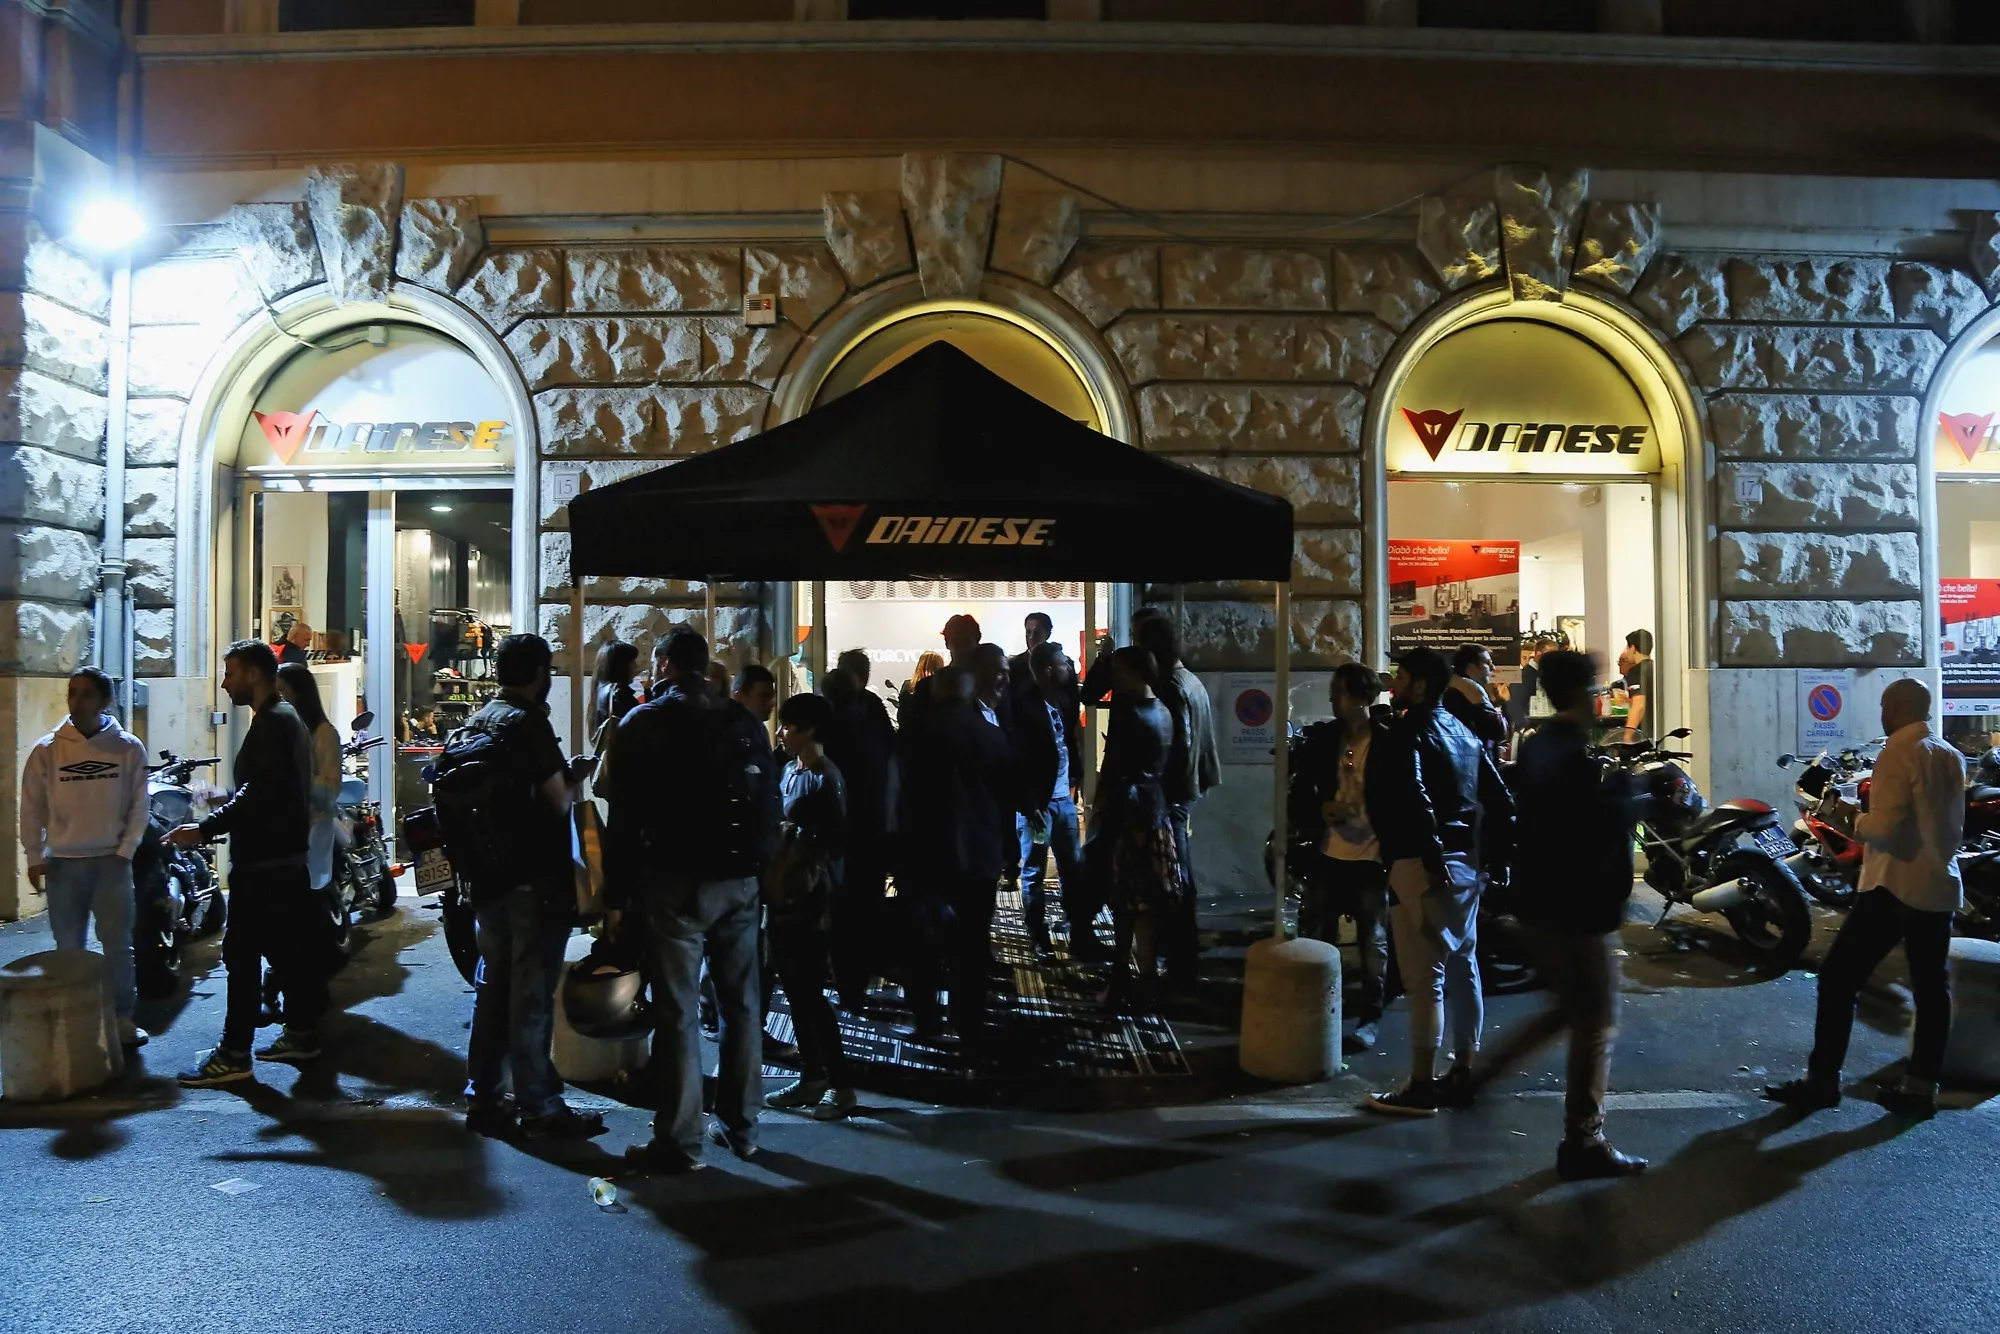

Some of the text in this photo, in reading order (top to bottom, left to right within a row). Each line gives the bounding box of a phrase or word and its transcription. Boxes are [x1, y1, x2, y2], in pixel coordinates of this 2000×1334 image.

[1455, 422, 1649, 454] DAINESE
[559, 479, 573, 495] 15
[1741, 480, 1755, 496] 17
[865, 516, 1056, 546] DAINESE
[1412, 545, 1427, 555] che
[1806, 729, 1845, 738] CARRABILE
[1814, 722, 1837, 730] PASSO
